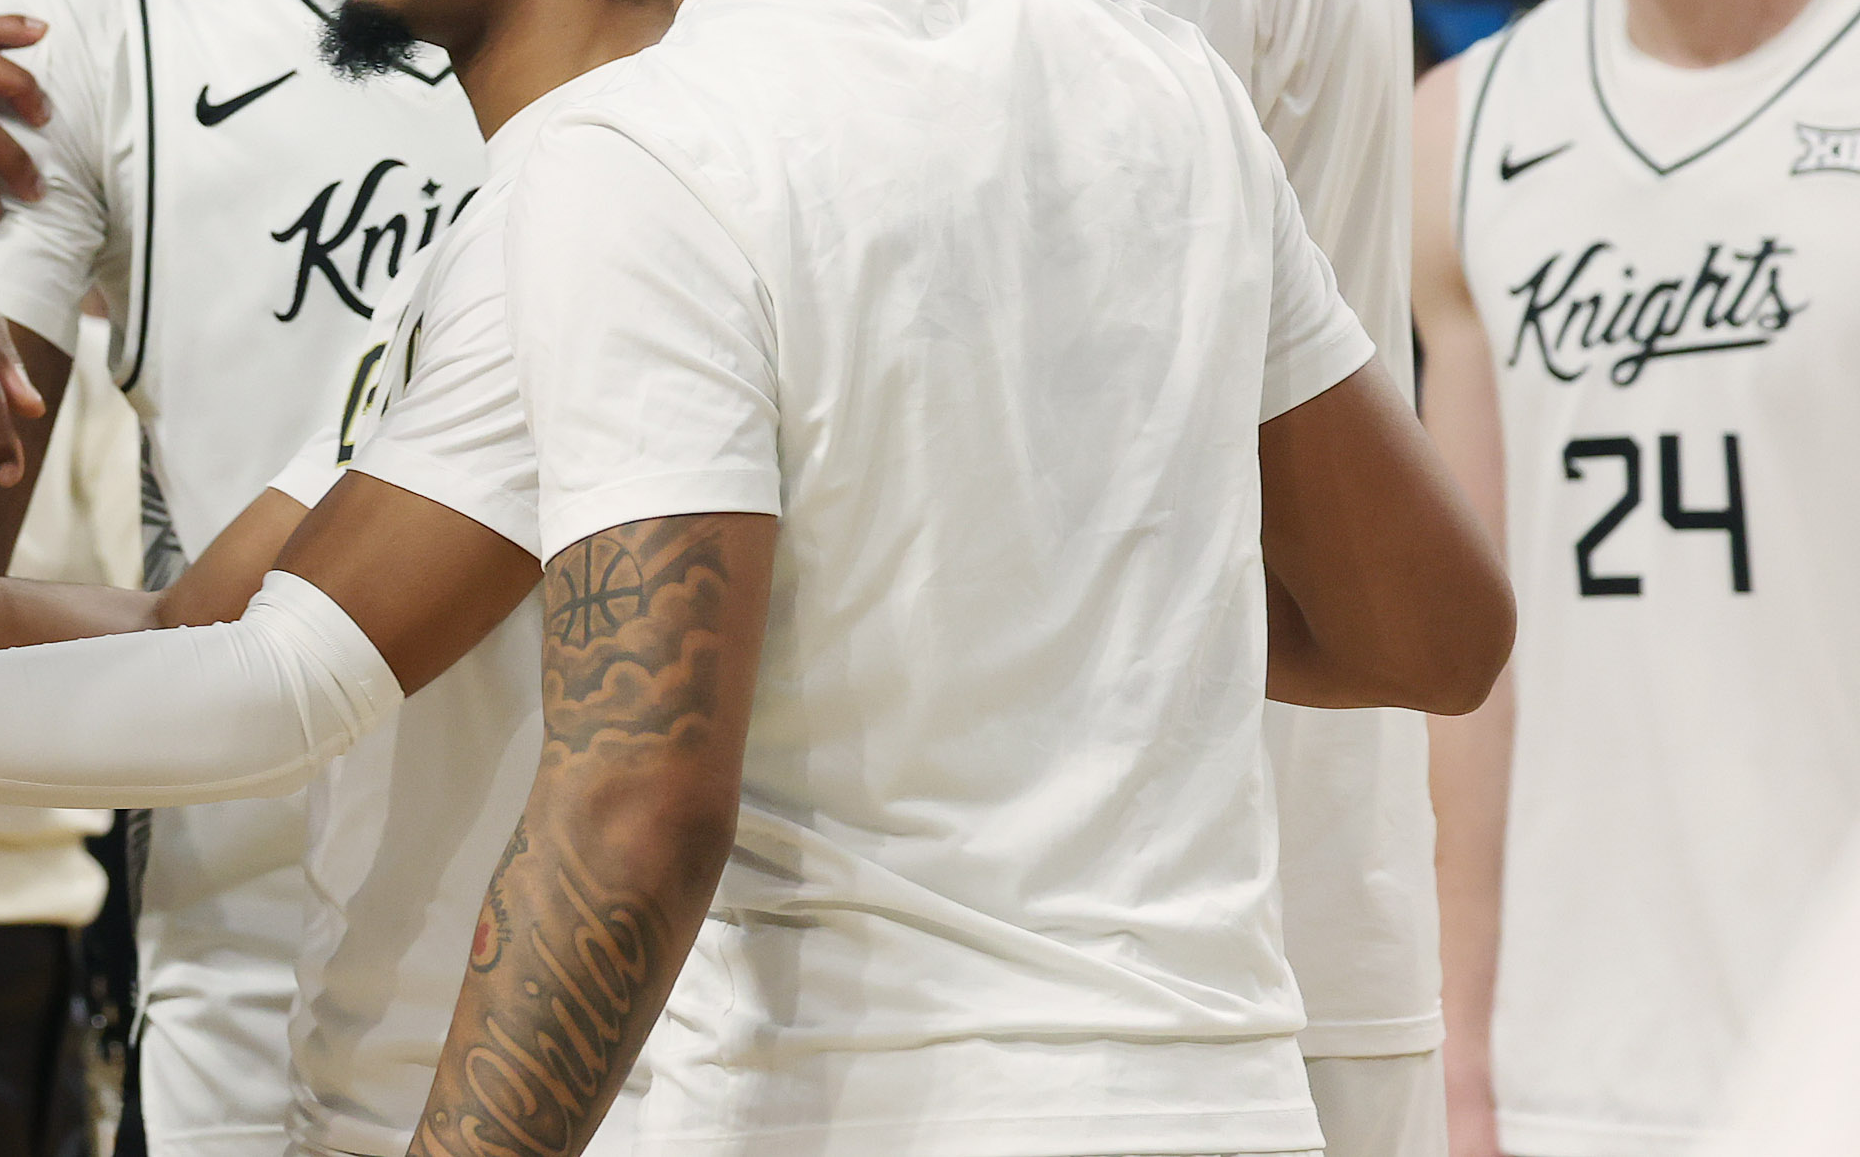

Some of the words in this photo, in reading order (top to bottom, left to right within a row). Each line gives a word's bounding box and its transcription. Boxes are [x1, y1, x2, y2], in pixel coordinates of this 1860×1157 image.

[271, 158, 480, 322] Kni
[1506, 236, 1811, 389] Knights
[1563, 434, 1753, 597] 24
